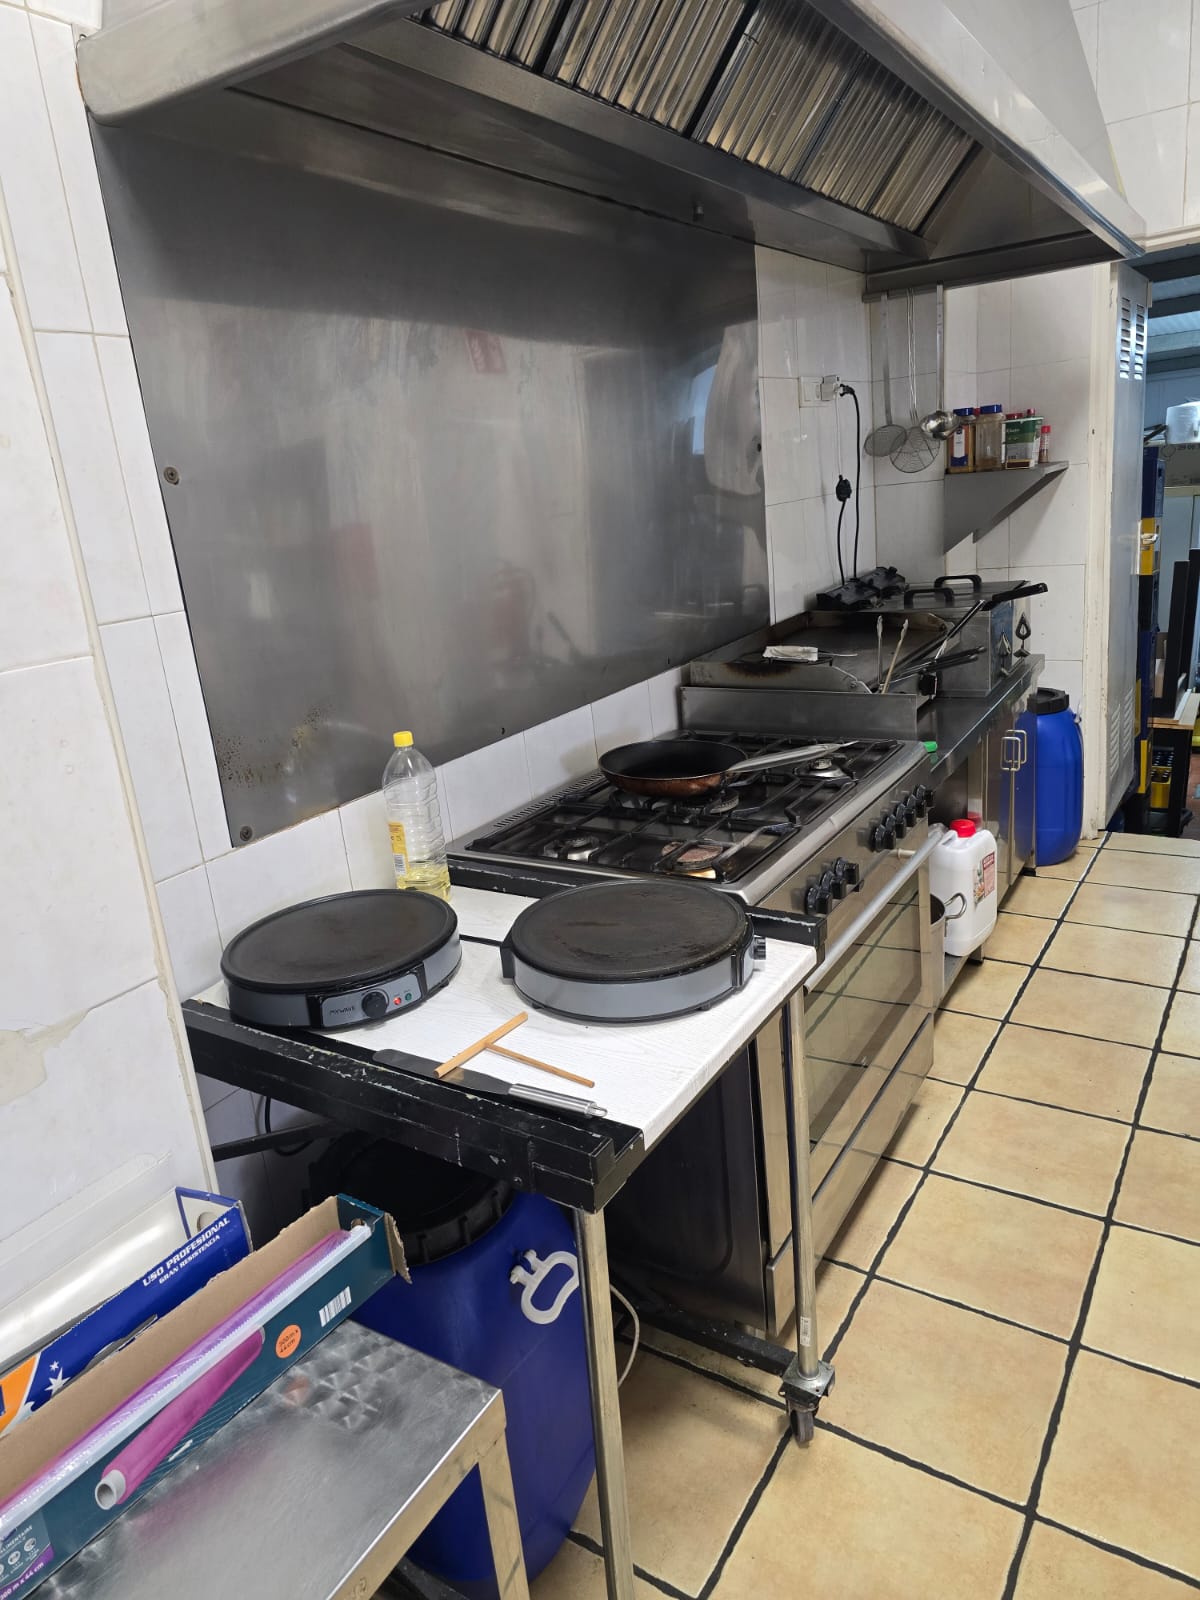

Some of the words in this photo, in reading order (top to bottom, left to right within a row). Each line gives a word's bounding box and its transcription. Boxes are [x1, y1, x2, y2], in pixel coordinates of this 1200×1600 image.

[143, 1266, 164, 1286] USO
[166, 1217, 230, 1269] PROFESIONAL
[159, 1266, 179, 1284] GRAN
[179, 1235, 220, 1268] RESISTENCIA
